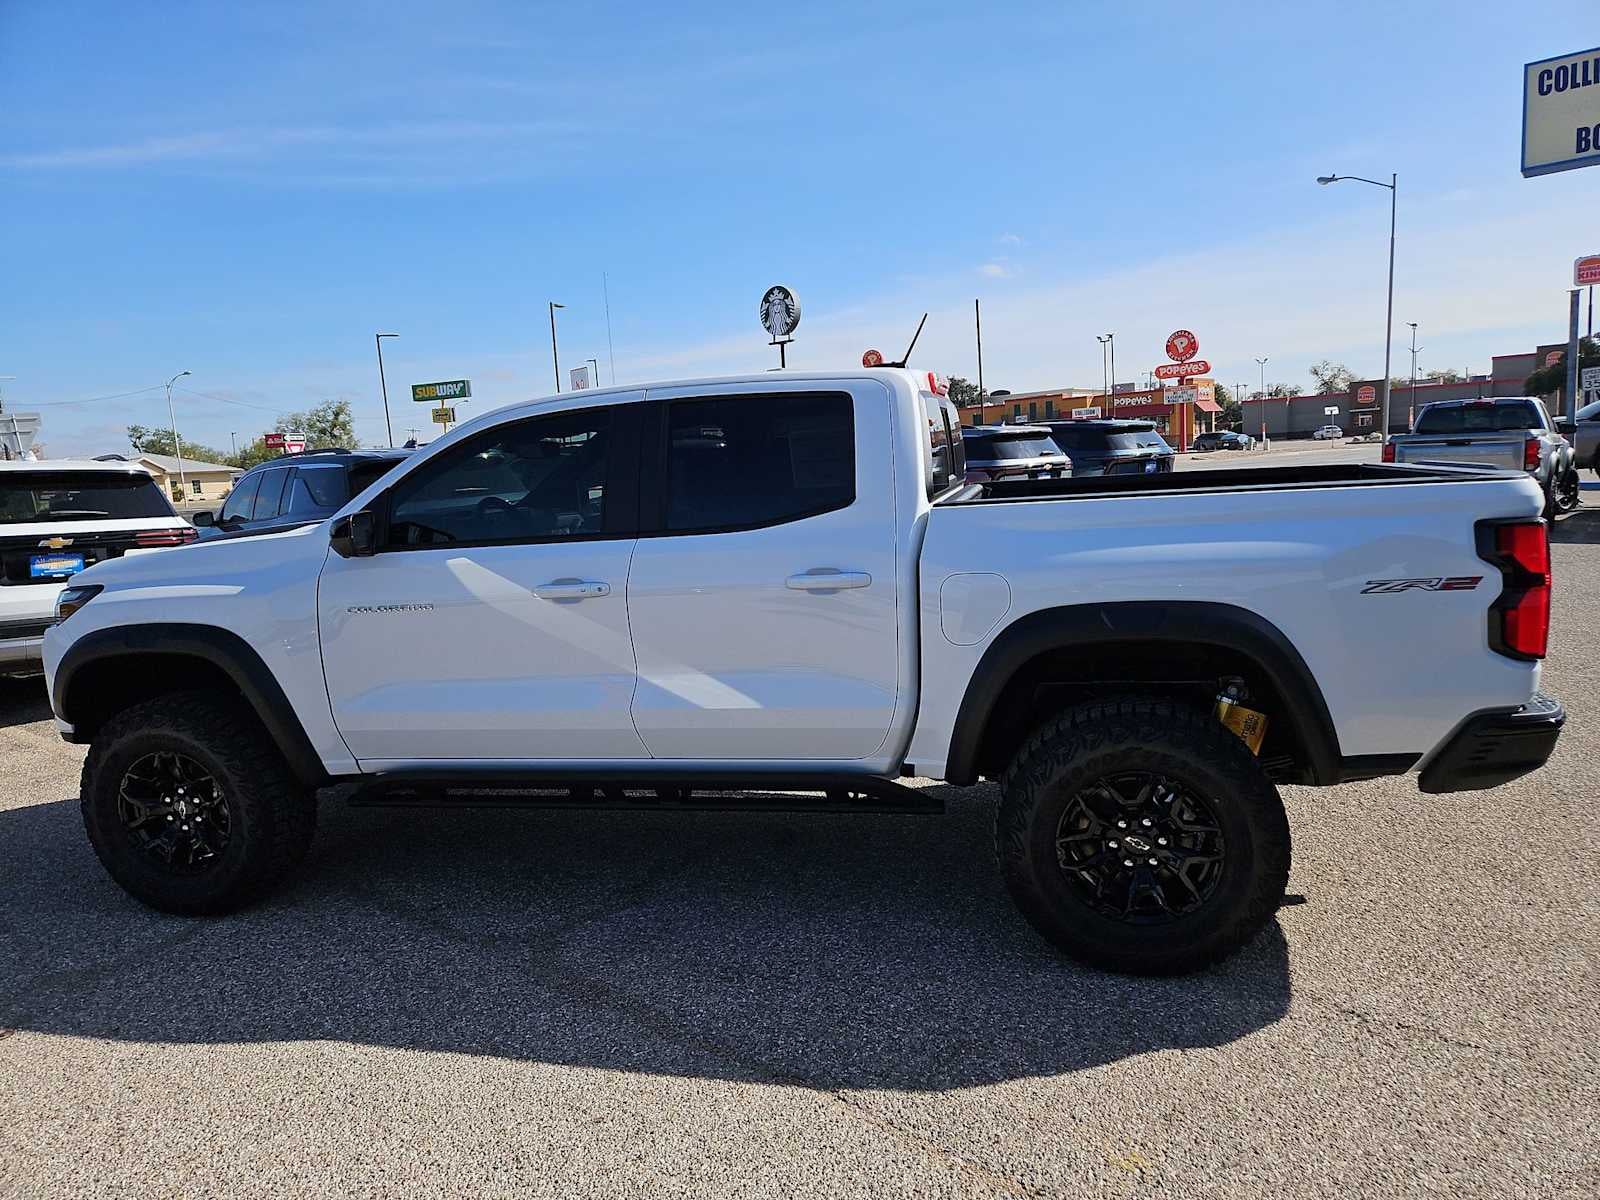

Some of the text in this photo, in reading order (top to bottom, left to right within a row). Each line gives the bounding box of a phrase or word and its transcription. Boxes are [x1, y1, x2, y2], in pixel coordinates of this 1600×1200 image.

[415, 383, 464, 398] SUBWAY
[1360, 576, 1484, 595] ZR2
[346, 603, 434, 615] COLORADO
